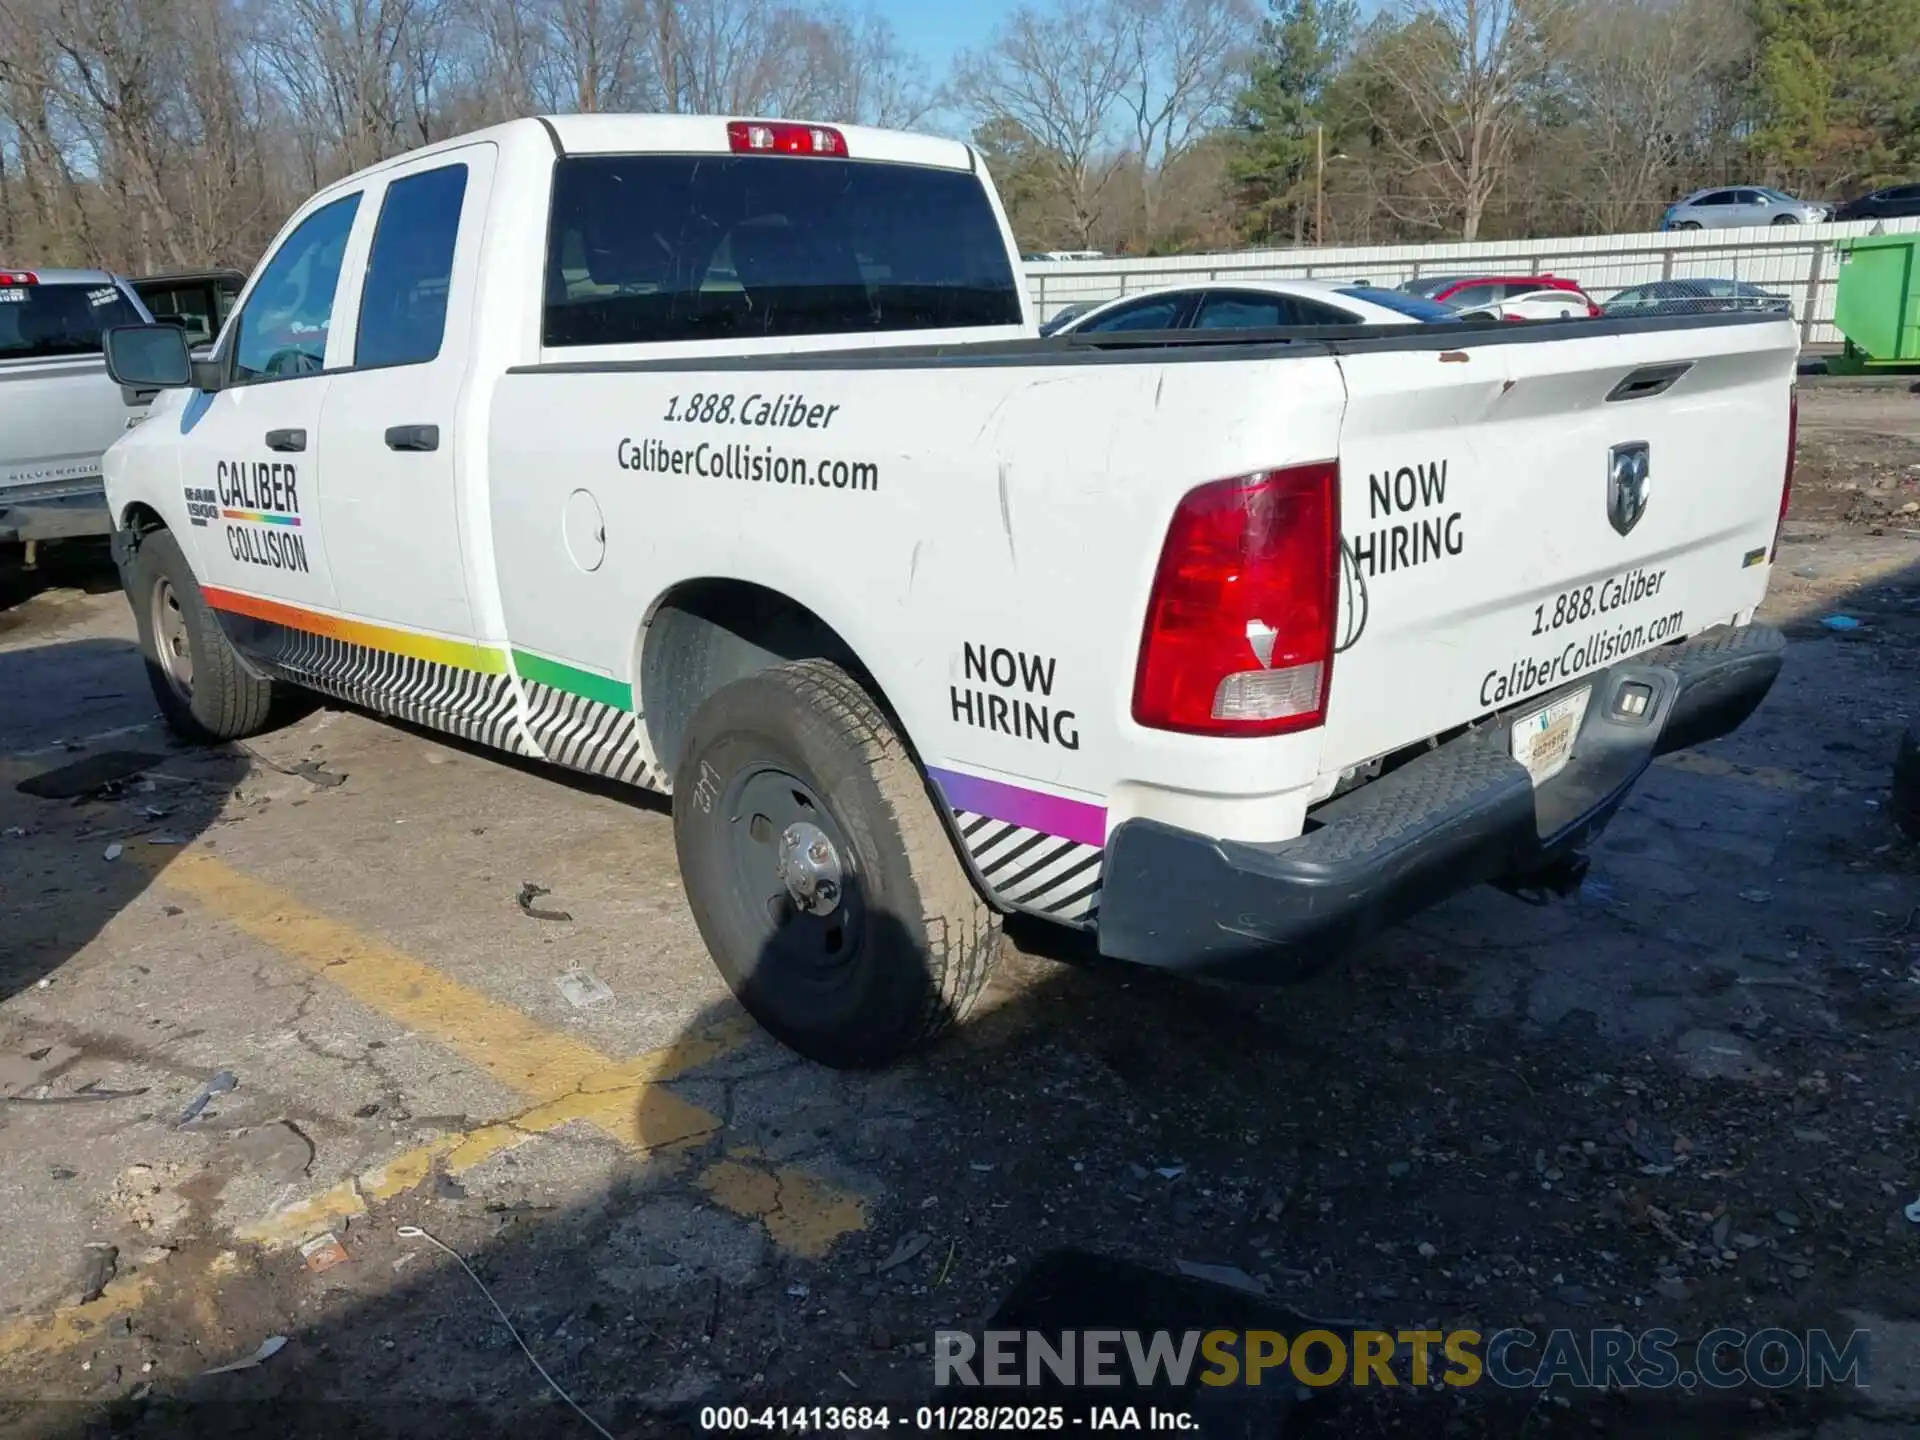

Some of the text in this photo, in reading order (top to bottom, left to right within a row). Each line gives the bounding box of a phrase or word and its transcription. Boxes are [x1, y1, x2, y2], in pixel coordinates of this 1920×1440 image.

[663, 393, 839, 428] 1.888.Caliber
[218, 460, 300, 513] CALIBER
[618, 437, 878, 491] CaliberCollision.com
[1369, 459, 1447, 519] NOW
[226, 525, 309, 574] COLLISION
[1355, 512, 1463, 580] HIRING
[1531, 569, 1666, 636] 1.888.Caliber
[963, 641, 1057, 697] NOW
[1480, 610, 1684, 706] CaliberCollision.com
[950, 685, 1079, 750] HIRING
